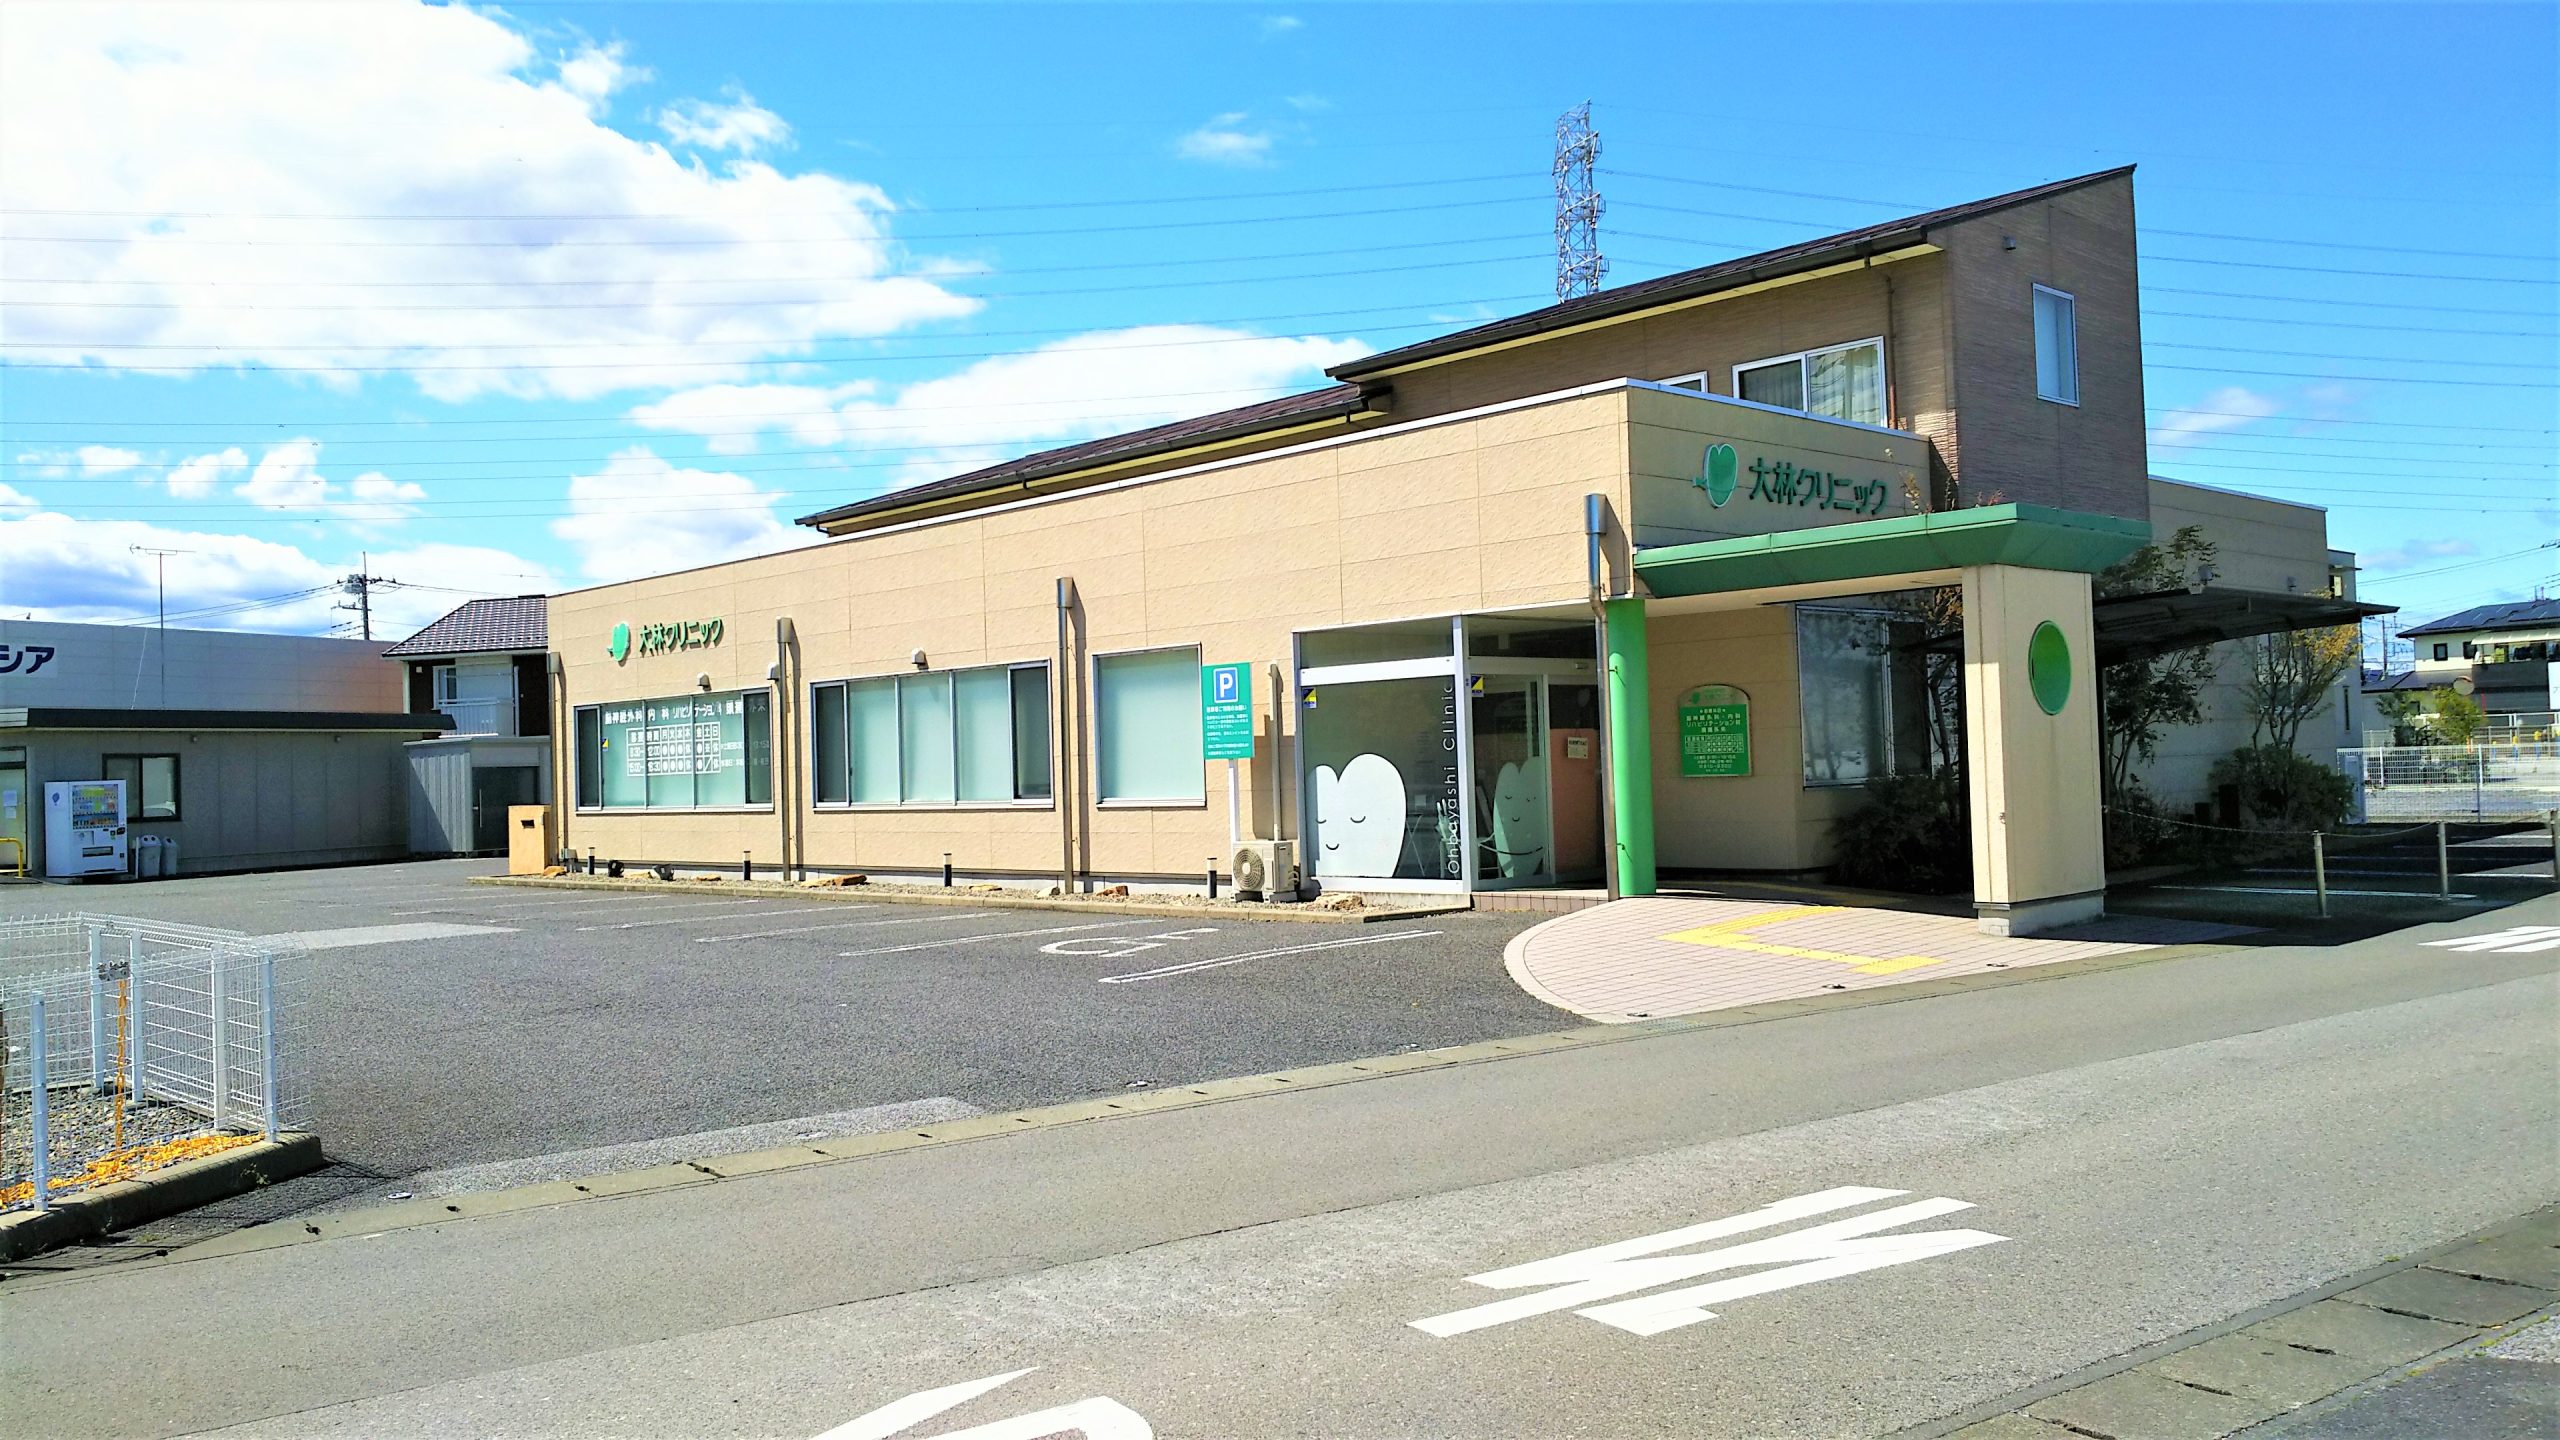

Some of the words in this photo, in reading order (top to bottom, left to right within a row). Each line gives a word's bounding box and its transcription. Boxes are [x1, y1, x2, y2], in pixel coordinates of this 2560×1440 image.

[1748, 457, 1889, 515] 大林クリニック
[639, 617, 723, 655] 大林クリニック
[1219, 672, 1234, 698] P
[1441, 686, 1456, 751] Clinic
[1443, 766, 1461, 874] Ohbayashi
